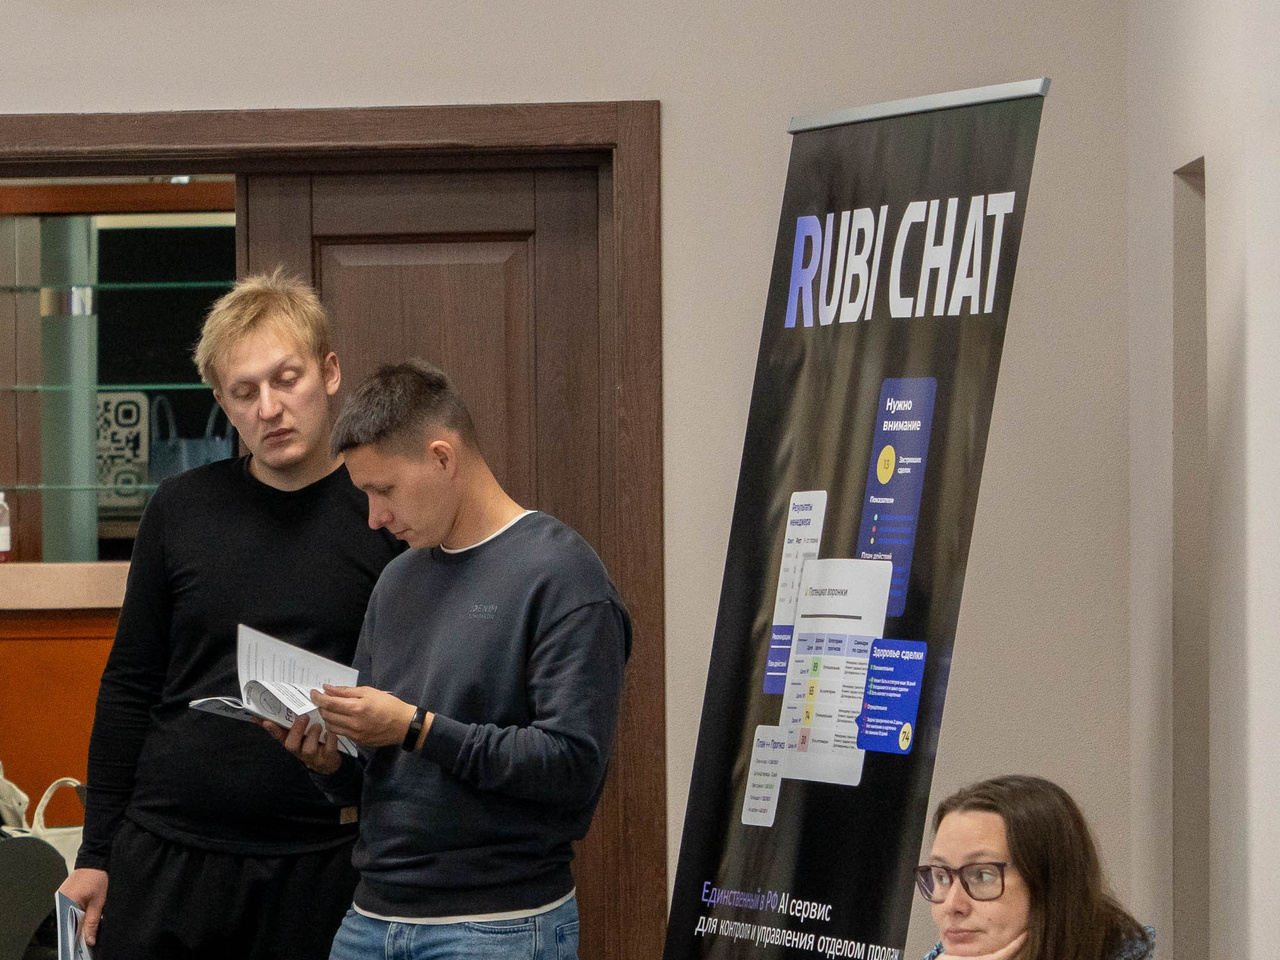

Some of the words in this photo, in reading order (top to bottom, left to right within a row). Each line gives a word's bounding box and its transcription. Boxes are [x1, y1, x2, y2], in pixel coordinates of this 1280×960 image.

[785, 205, 888, 328] RUBI
[889, 191, 1015, 318] CHAT
[886, 398, 912, 414] Нужно
[883, 420, 921, 431] внимание
[873, 646, 900, 660] Здоровье
[901, 650, 924, 661] сделки
[901, 731, 910, 743] 74
[701, 881, 760, 908] Единственный
[765, 891, 778, 911] РФ
[778, 892, 788, 914] AI
[789, 899, 832, 923] сервис
[695, 916, 718, 936] для
[719, 919, 750, 943] контроля
[750, 924, 756, 940] и
[756, 926, 815, 950] управления
[817, 935, 865, 960] отделом
